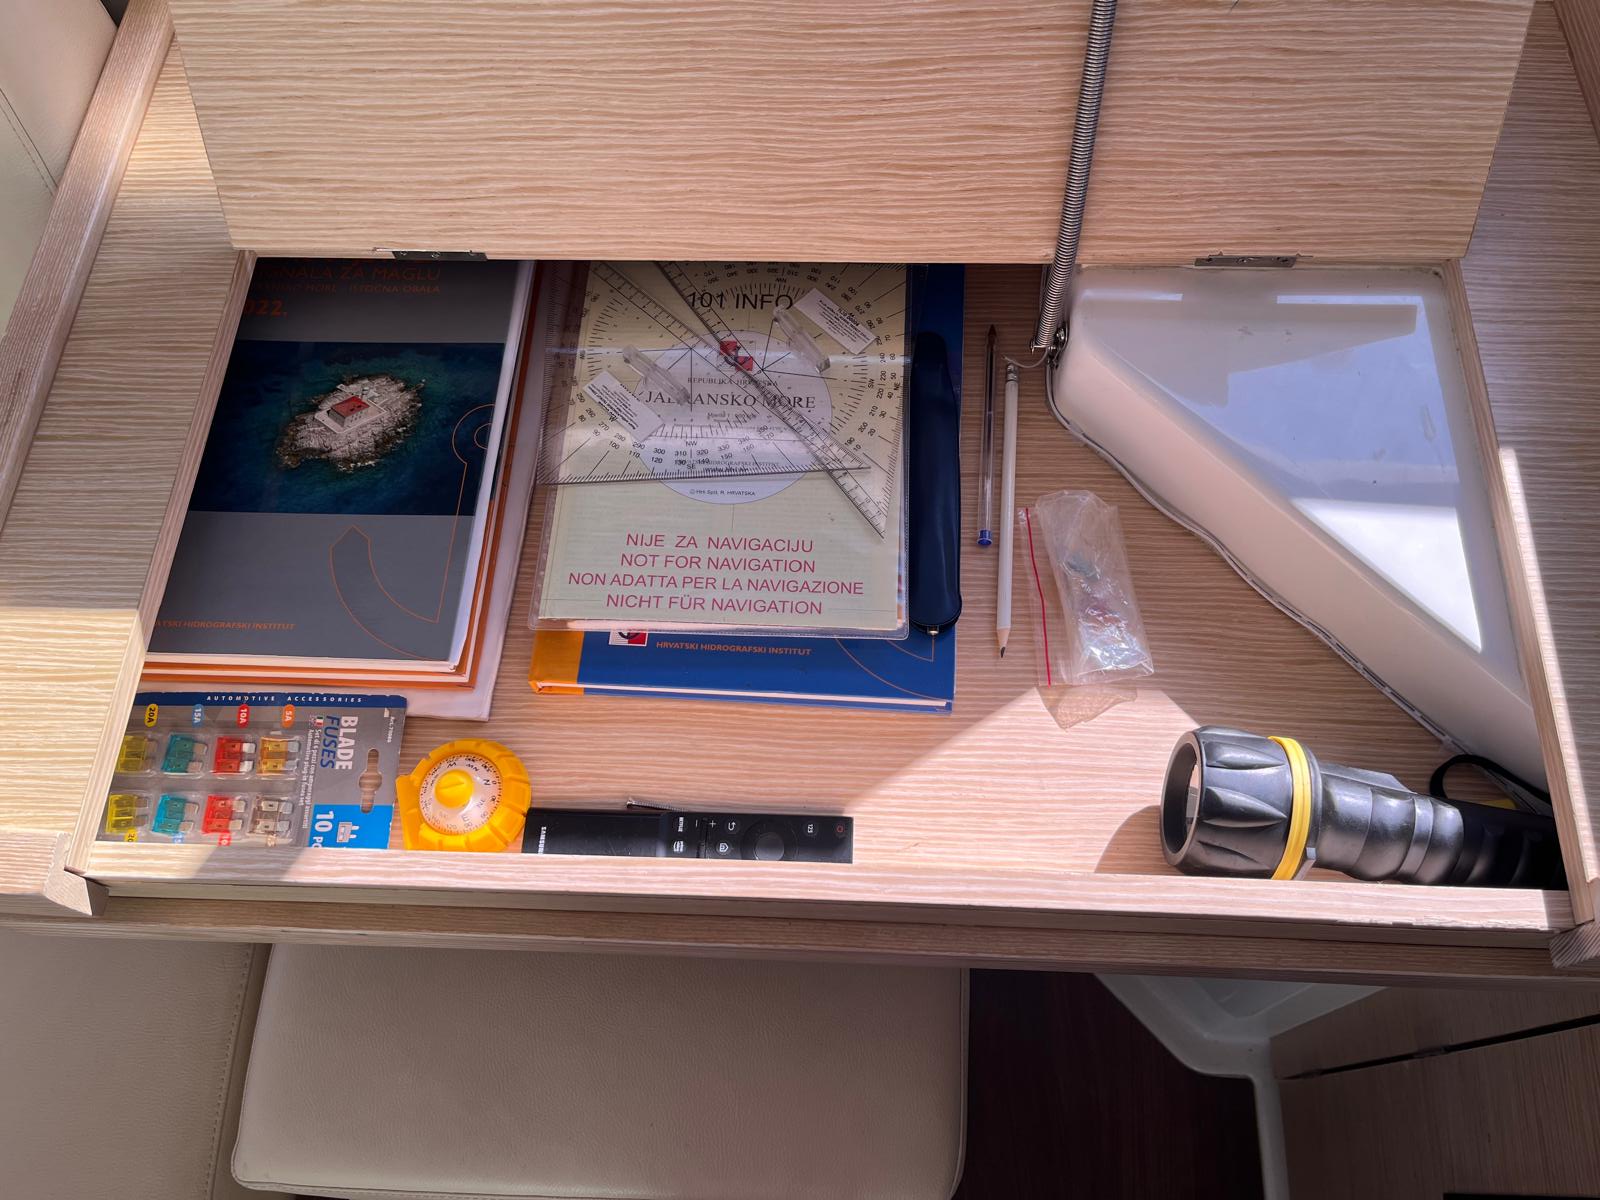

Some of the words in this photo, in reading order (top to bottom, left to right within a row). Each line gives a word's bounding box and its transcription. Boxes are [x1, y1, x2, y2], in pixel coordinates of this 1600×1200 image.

[340, 266, 364, 280] ZA
[372, 266, 441, 281] MAGLU
[688, 291, 725, 308] 101
[735, 293, 793, 310] INFO
[879, 370, 887, 381] 230
[876, 387, 885, 399] 220
[887, 391, 894, 399] 40
[868, 405, 879, 417] 210
[598, 421, 610, 431] 270
[857, 421, 869, 433] 200
[867, 428, 876, 437] 20
[608, 440, 620, 450] 100
[632, 441, 646, 450] 290
[652, 447, 666, 455] 300
[853, 444, 862, 452] 10
[629, 450, 640, 458] 110
[696, 448, 709, 456] 320
[720, 452, 733, 460] 150
[625, 532, 666, 548] NIJE
[675, 534, 698, 549] ZA
[707, 536, 815, 553] NAVIGACIJU
[620, 553, 658, 568] NOT
[664, 555, 701, 570] FOR
[707, 557, 816, 574] NAVIGATION
[568, 572, 606, 586] NON
[610, 574, 677, 589] ADATTA
[682, 576, 717, 590] PER
[722, 577, 743, 591] LA
[747, 579, 864, 595] NAVIGAZIONE
[606, 594, 664, 609] NICHT
[668, 594, 706, 610] FÜR
[711, 598, 823, 615] NAVIGATION
[252, 622, 297, 631] INSTITUT
[656, 641, 699, 650] HRVATSKI
[700, 643, 768, 654] HIDROGRAFSKI
[768, 647, 812, 656] INSTITUT
[286, 696, 363, 704] ACCESSORIES
[146, 707, 156, 724] 20A
[193, 708, 202, 724] 15A
[240, 707, 248, 724] 10A
[284, 709, 293, 722] 5A
[320, 715, 340, 769] FUSES
[335, 716, 359, 770] BLADE
[314, 810, 334, 832] 10
[460, 814, 470, 822] E
